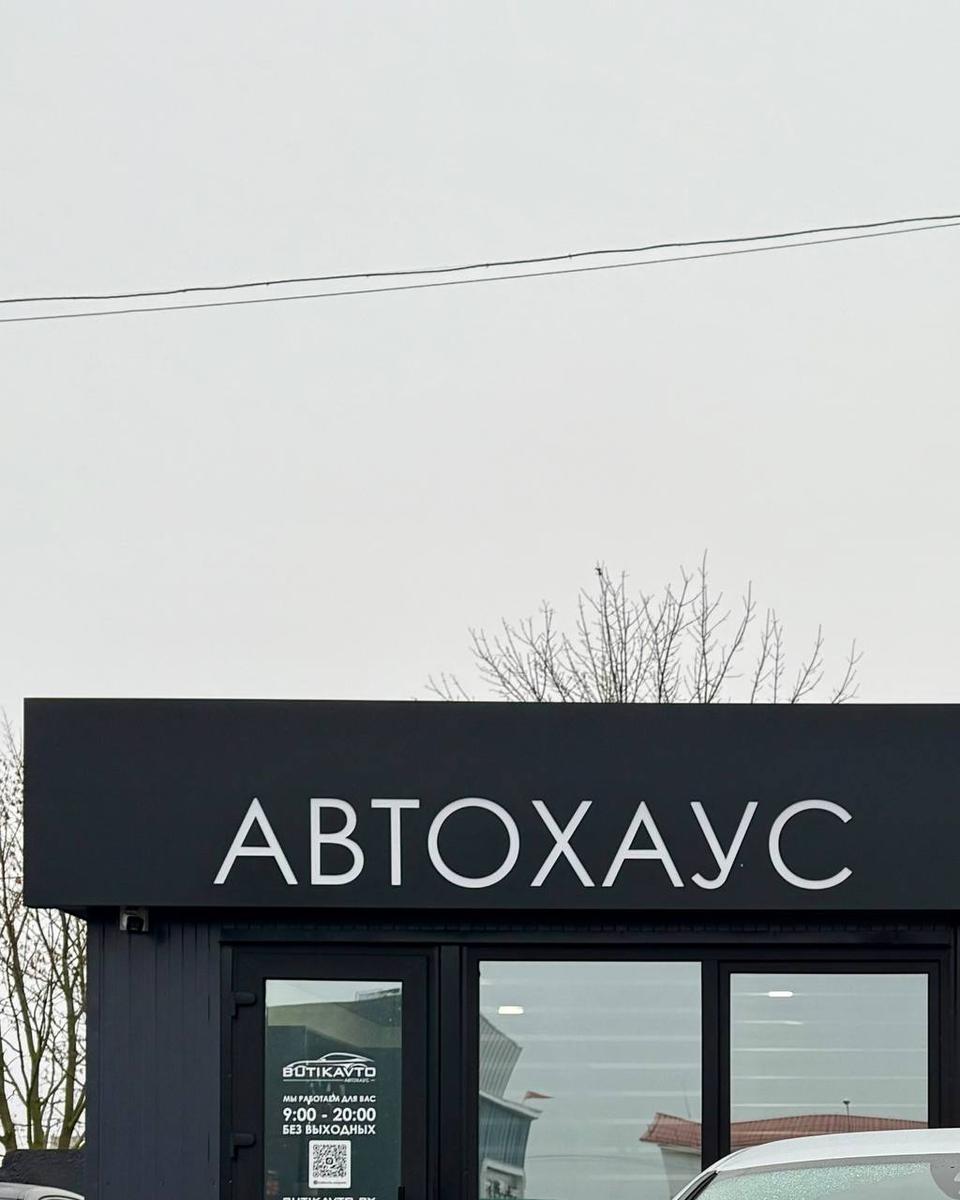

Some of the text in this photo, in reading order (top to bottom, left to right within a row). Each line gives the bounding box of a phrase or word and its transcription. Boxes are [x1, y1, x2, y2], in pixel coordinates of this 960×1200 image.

[214, 797, 853, 890] АВТОХАУС
[282, 1067, 376, 1077] BUTIKAVTO
[282, 1095, 297, 1103] МЫ
[341, 1095, 358, 1103] ДЛЯ
[359, 1095, 376, 1103] ВАС
[282, 1107, 317, 1122] 9:00
[332, 1107, 376, 1122] 20:00
[282, 1124, 376, 1136] БЕЗ ВЫХОДНЫХ
